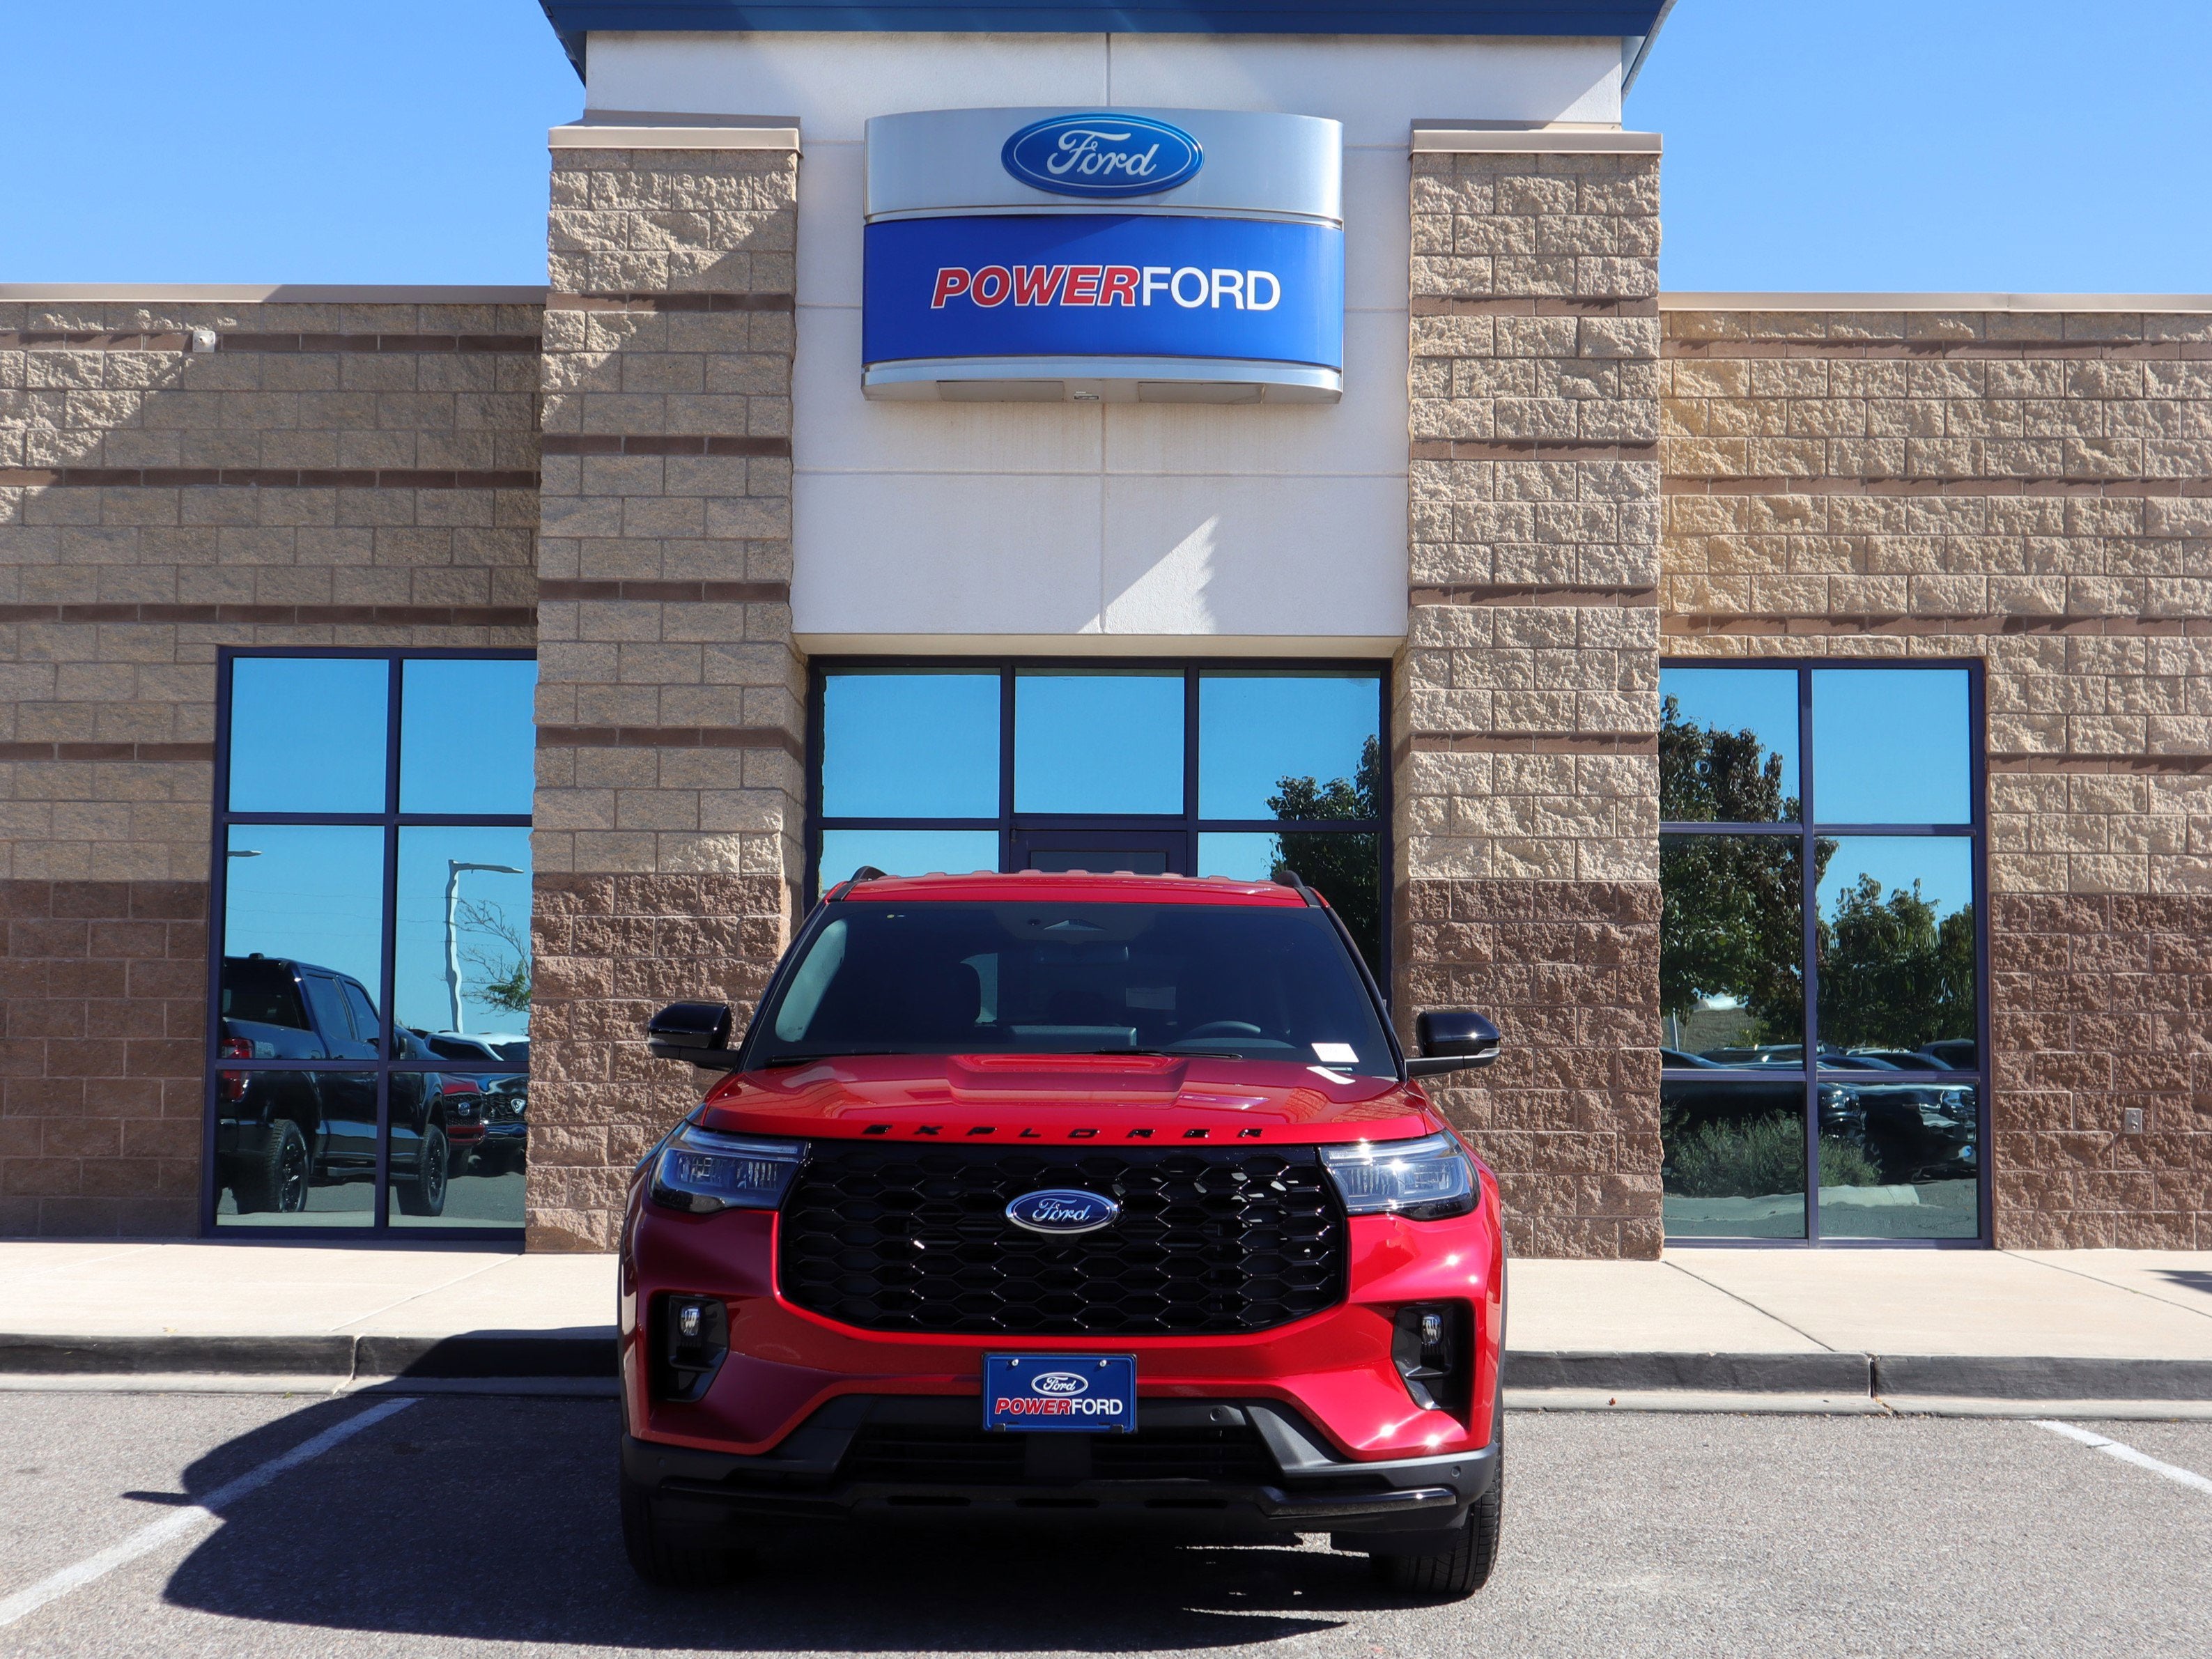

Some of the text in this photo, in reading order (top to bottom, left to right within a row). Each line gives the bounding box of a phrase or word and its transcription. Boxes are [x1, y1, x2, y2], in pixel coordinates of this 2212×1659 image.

[1046, 129, 1159, 176] Ford
[930, 265, 1281, 311] POWERFORD
[862, 1124, 1264, 1139] EXPLORER
[1031, 1198, 1092, 1223] Ford
[1042, 1376, 1076, 1391] Ford
[994, 1397, 1123, 1415] POWERFORD
